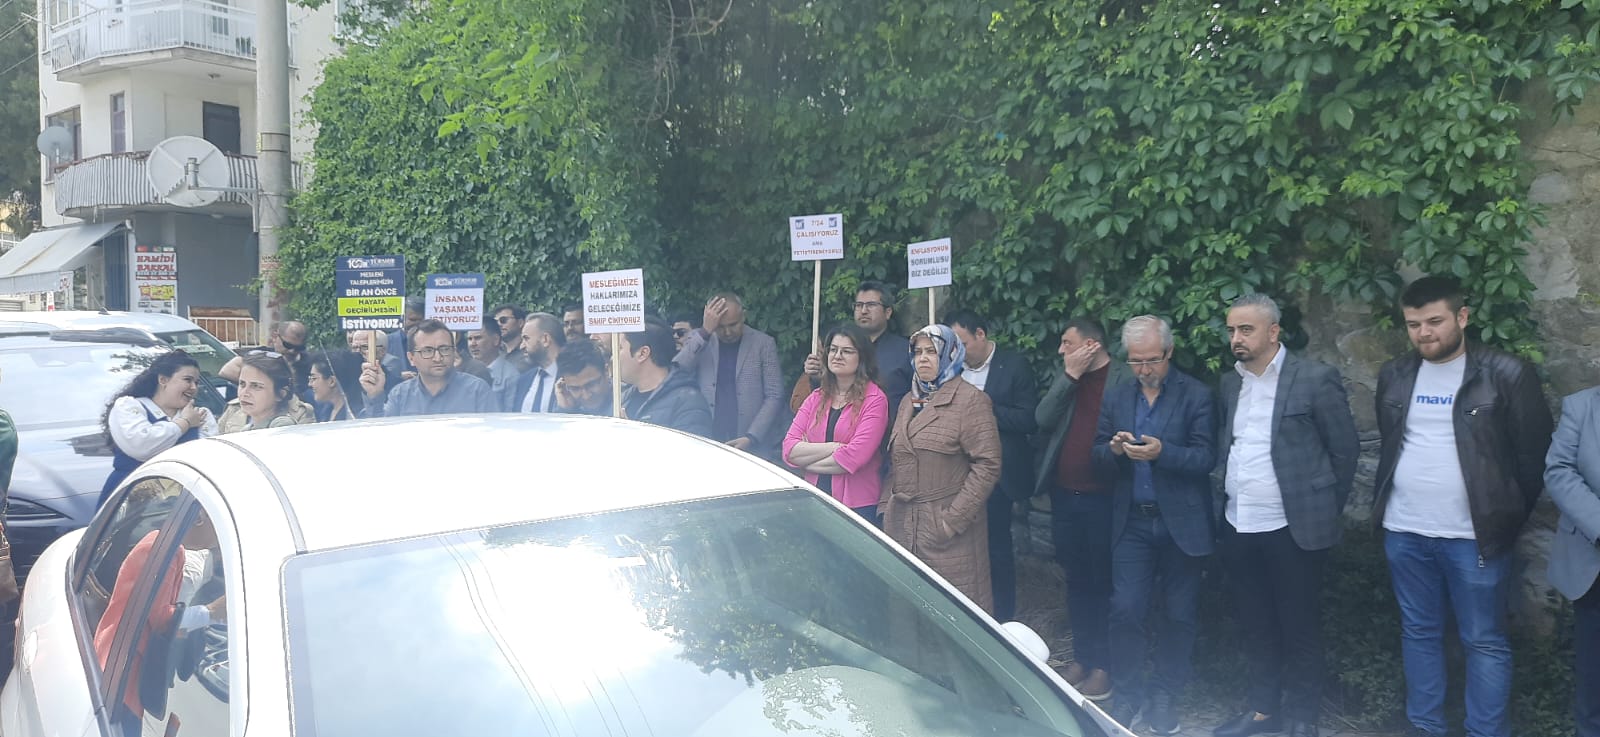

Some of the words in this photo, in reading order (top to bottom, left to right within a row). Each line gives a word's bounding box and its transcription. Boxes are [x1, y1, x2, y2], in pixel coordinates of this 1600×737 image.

[911, 256, 950, 266] SORUMLUSU
[589, 276, 639, 288] MESLEĞİMİZE
[346, 288, 360, 296] BİR
[361, 288, 373, 296] AN
[374, 286, 398, 296] ÖNCE
[590, 290, 638, 300] HAKLARIMIZA
[435, 294, 476, 303] İNSANCA
[346, 306, 398, 314] GEÇİRİLMESİNİ
[433, 306, 476, 314] YAŞAMAK
[588, 302, 641, 312] GELECEĞİMİZE
[342, 317, 403, 329] İSTİYORUZ.
[1416, 394, 1454, 405] mavi
